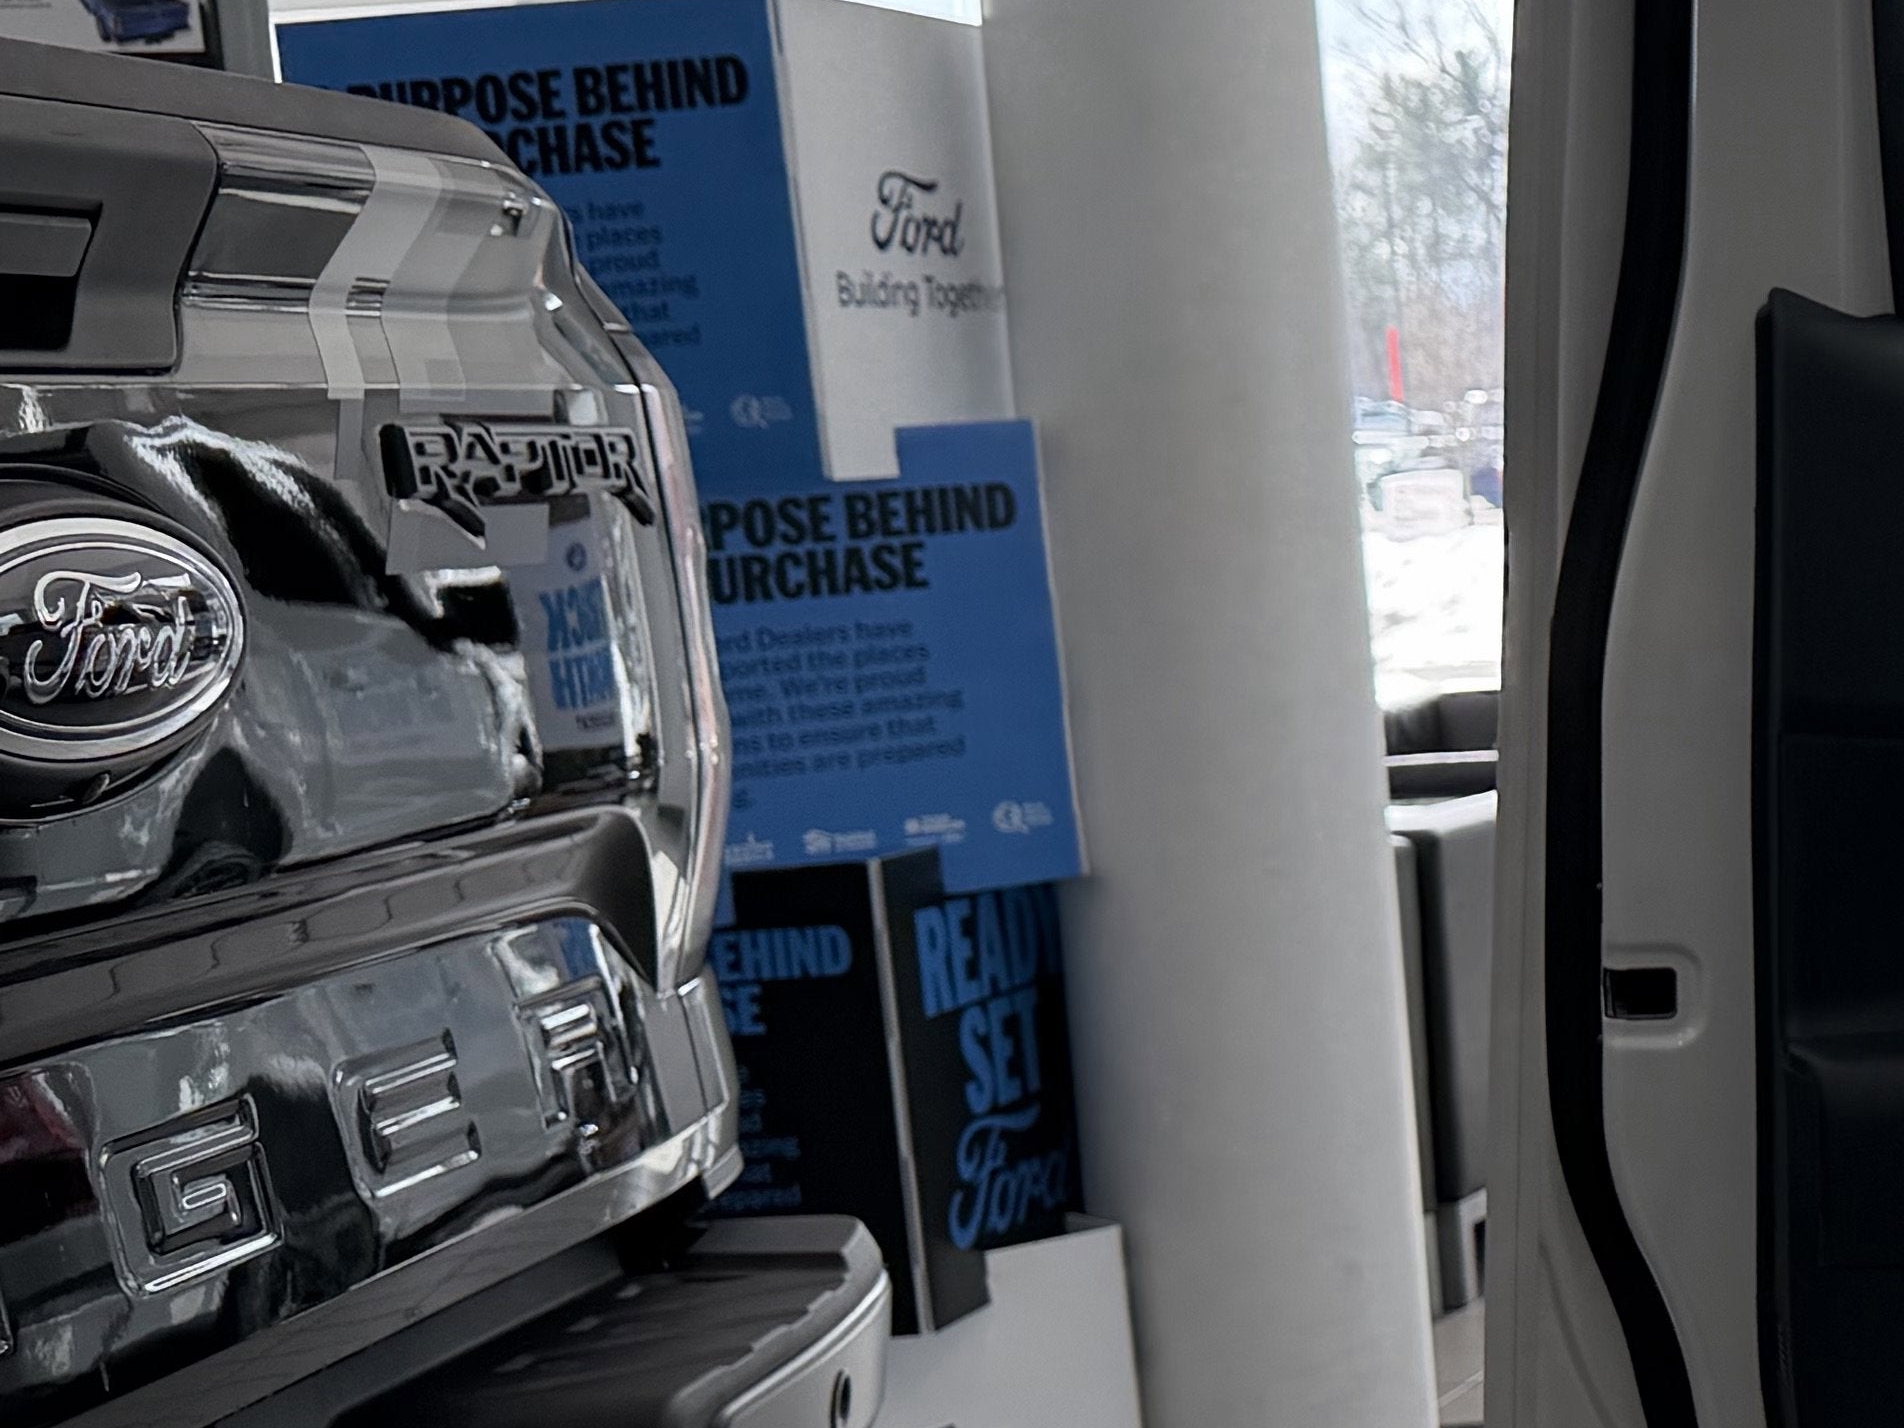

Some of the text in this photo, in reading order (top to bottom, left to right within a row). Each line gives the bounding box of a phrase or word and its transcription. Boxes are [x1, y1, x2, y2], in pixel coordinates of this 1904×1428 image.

[347, 54, 749, 125] POSE BEHIND
[870, 169, 964, 259] Ford
[379, 421, 657, 549] RAPTOR
[701, 481, 1018, 551] POSE BEHIND
[23, 570, 192, 705] Ford
[709, 924, 853, 982] EHIND
[959, 988, 1041, 1115] SET
[948, 1104, 1074, 1251] Ford
